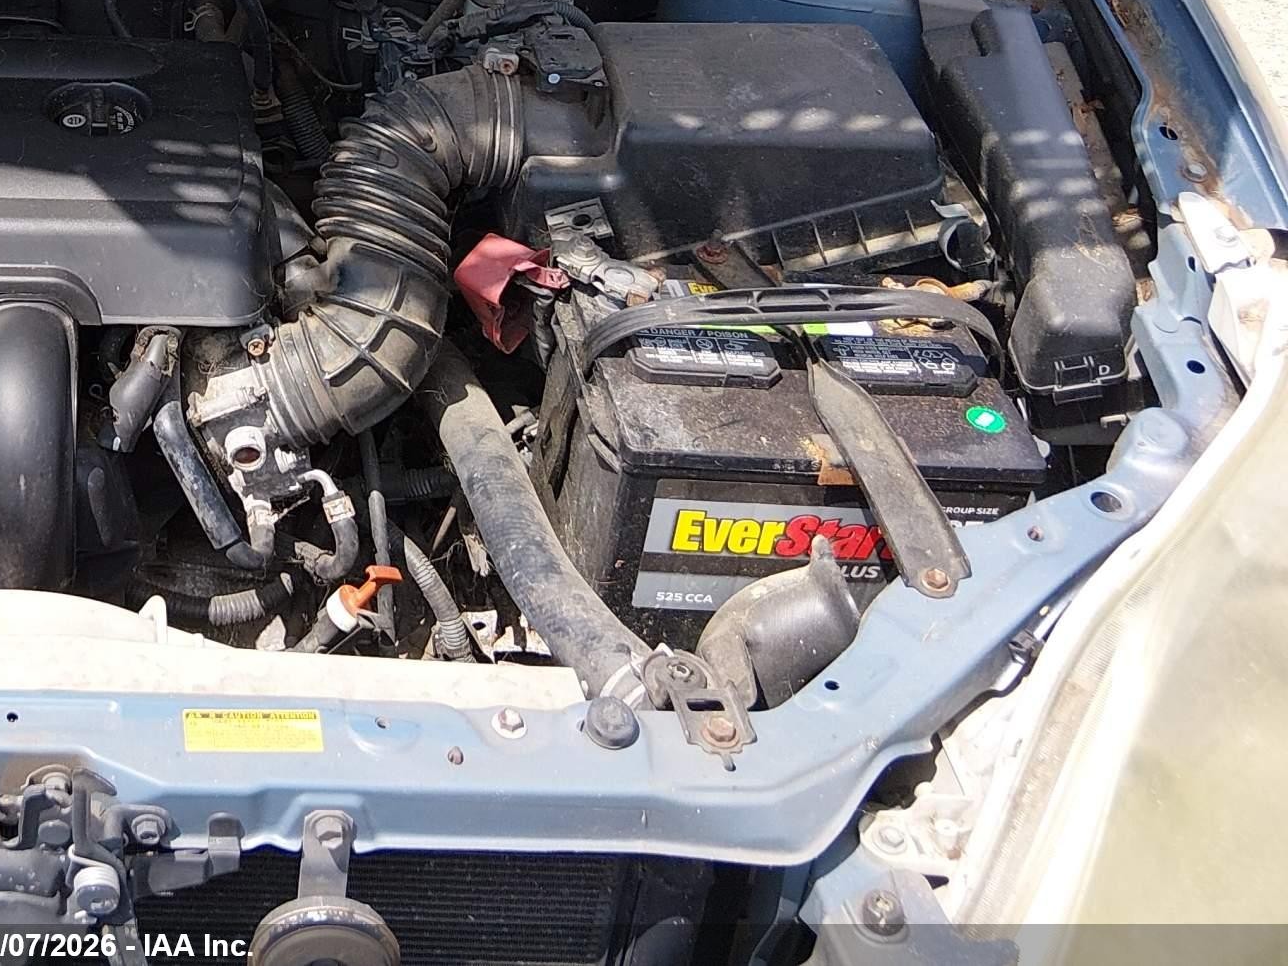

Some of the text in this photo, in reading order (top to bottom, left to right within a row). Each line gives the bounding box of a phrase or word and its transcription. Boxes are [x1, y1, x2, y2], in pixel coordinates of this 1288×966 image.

[650, 328, 696, 336] DANGER
[707, 330, 749, 339] POISON
[1098, 365, 1111, 376] D
[976, 507, 999, 515] SIZE
[837, 565, 881, 579] LUS
[656, 591, 713, 604] 525 CCA
